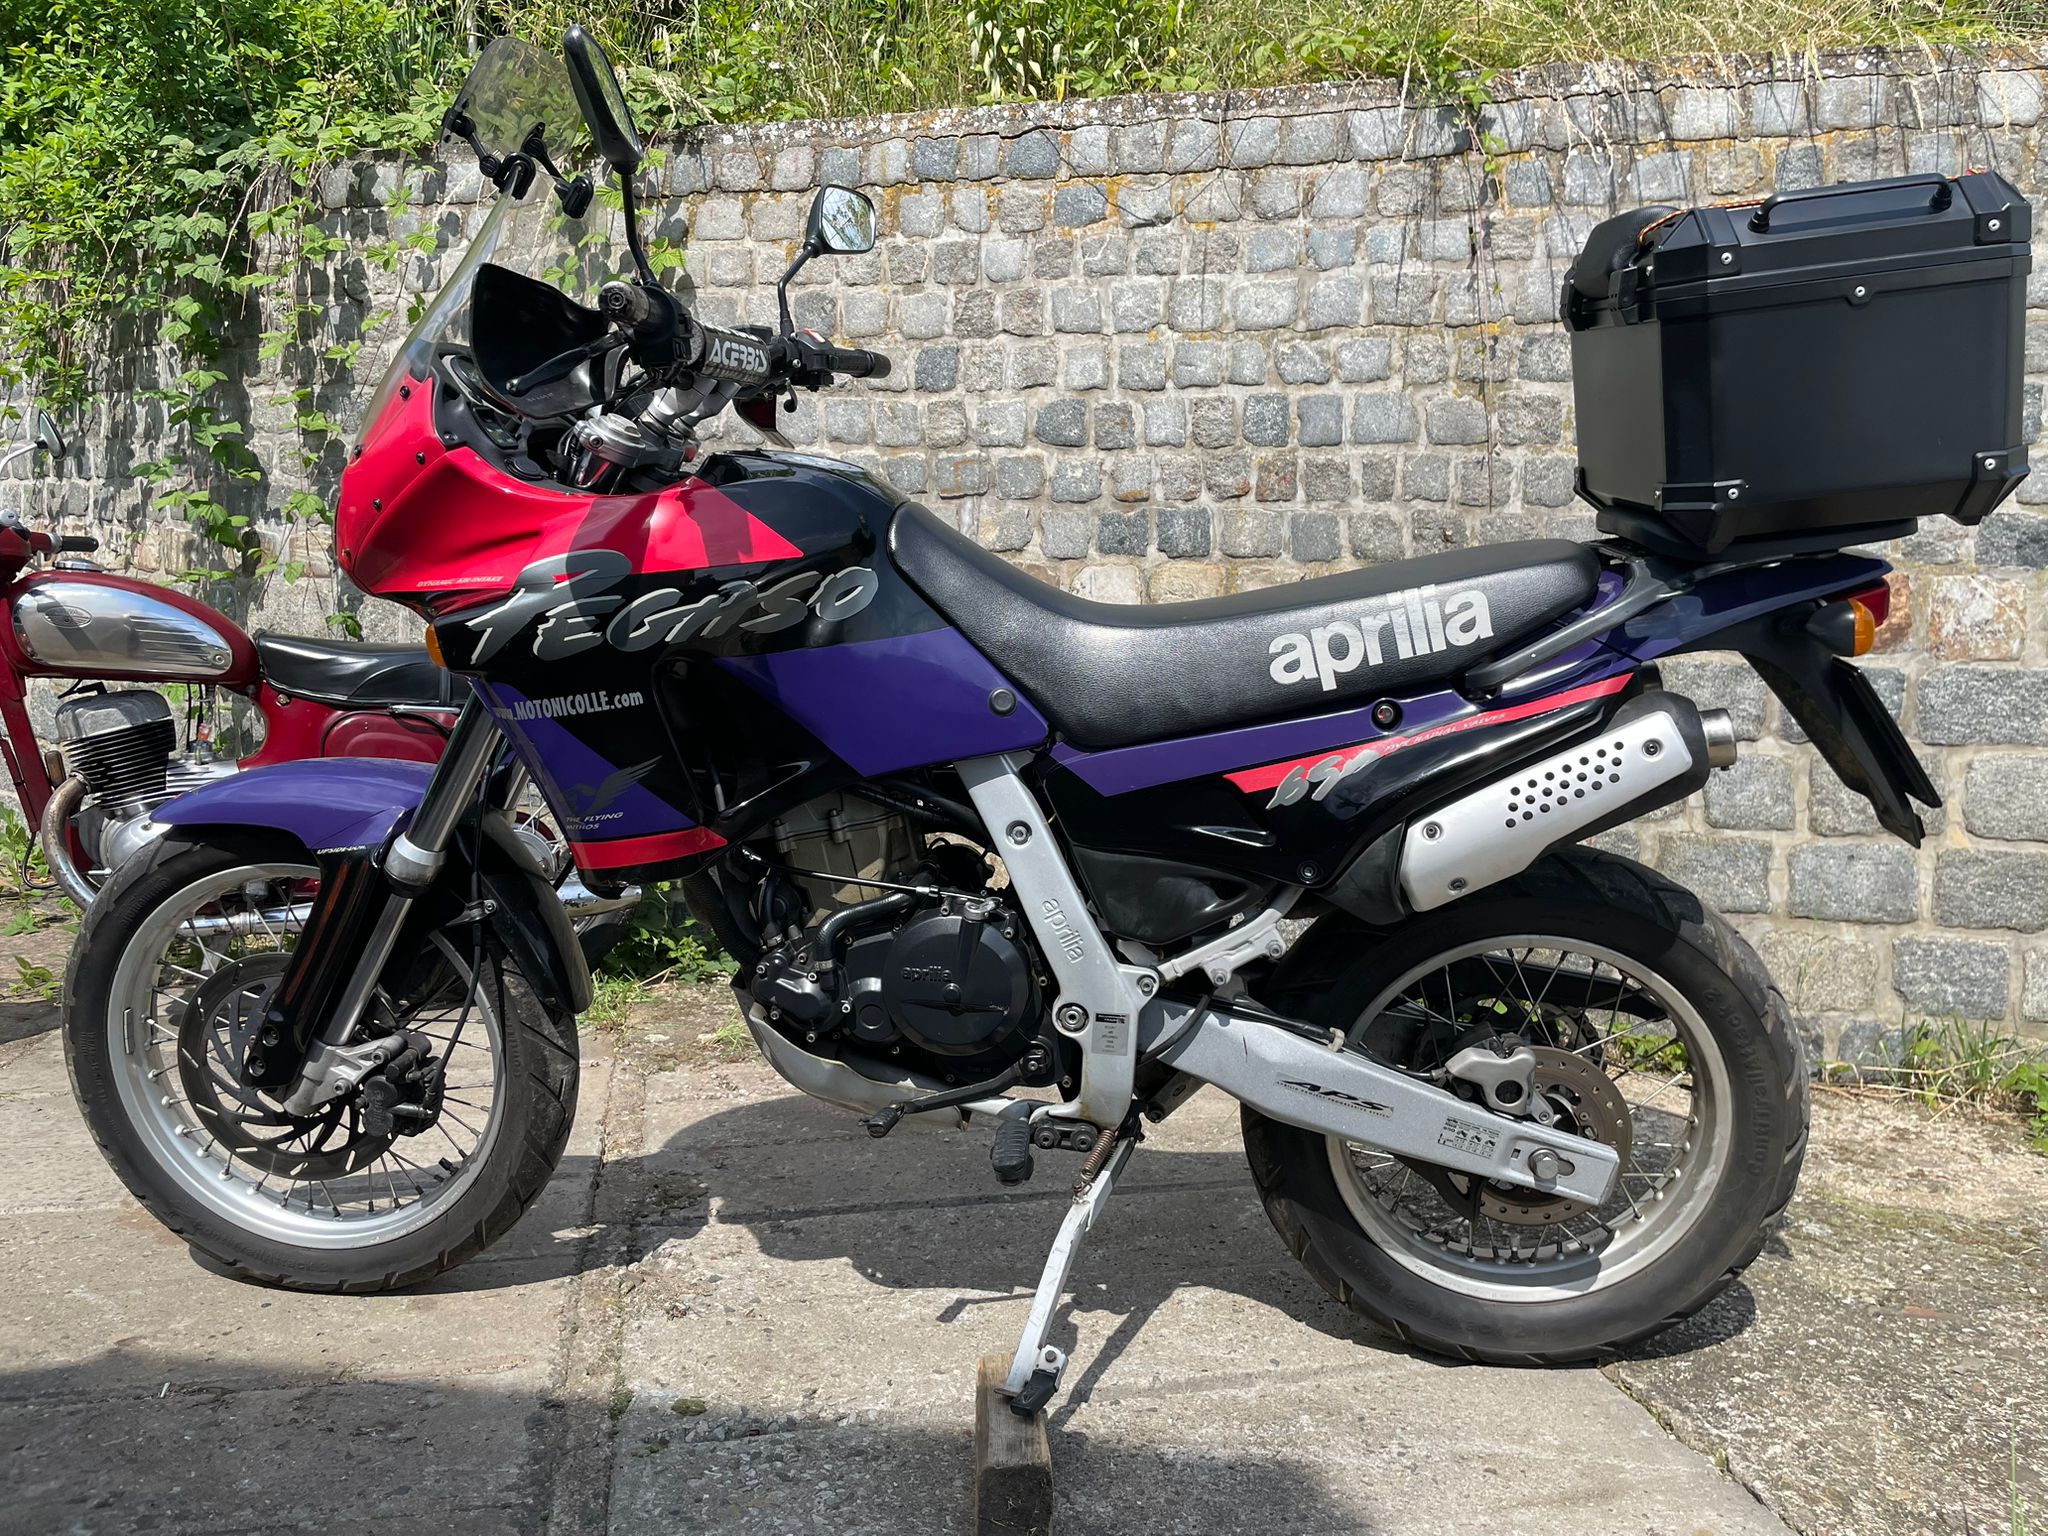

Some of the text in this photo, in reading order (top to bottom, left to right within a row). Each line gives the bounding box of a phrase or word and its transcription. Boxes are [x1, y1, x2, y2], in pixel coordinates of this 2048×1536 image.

[709, 338, 767, 373] ACERBIS
[465, 549, 878, 665] PEGASO
[1268, 584, 1494, 691] aprilia
[583, 811, 624, 823] FLYING
[1041, 898, 1085, 964] aprilia
[902, 965, 953, 983] aprilia
